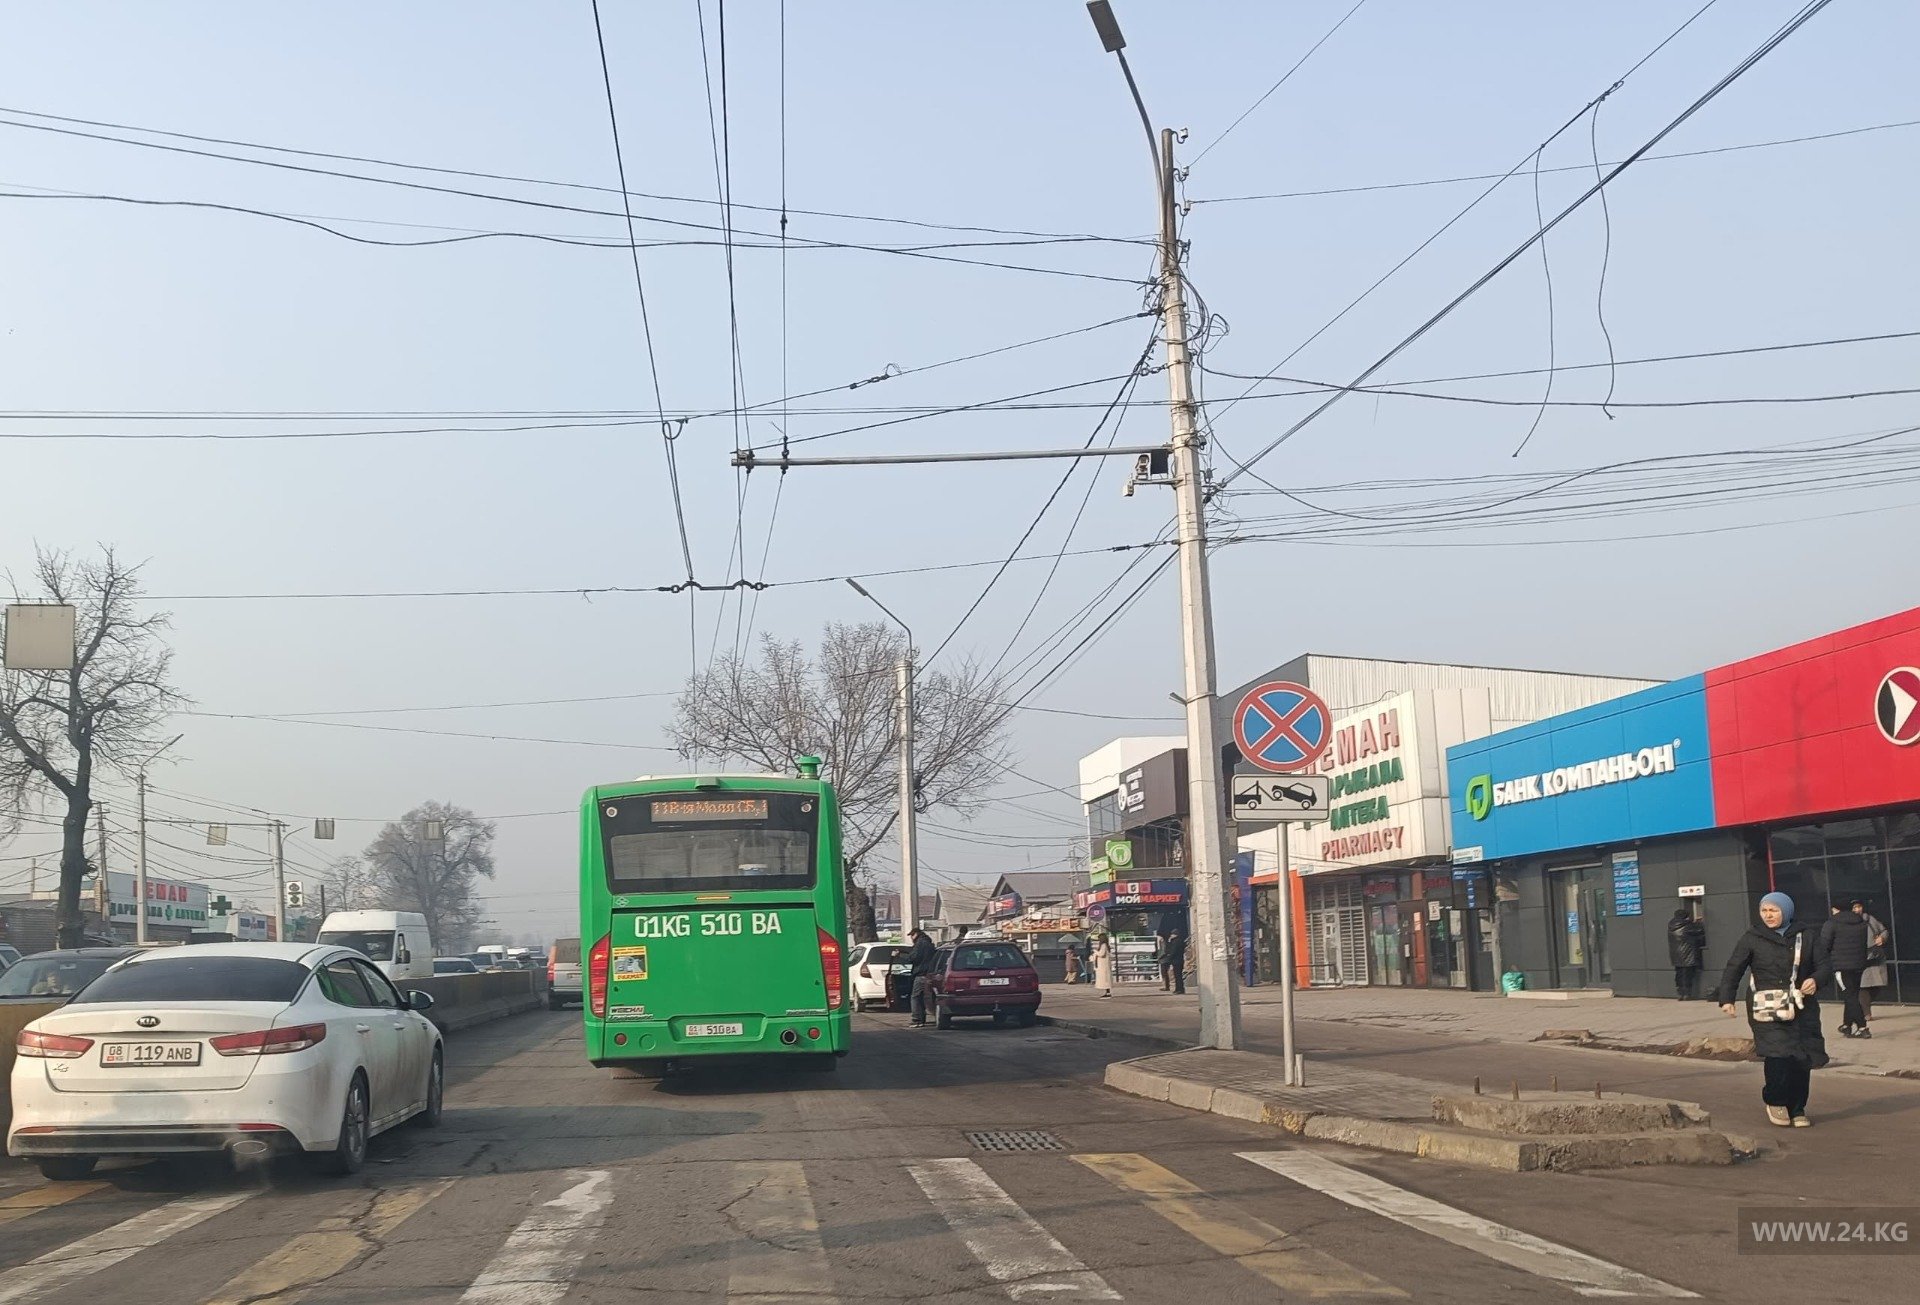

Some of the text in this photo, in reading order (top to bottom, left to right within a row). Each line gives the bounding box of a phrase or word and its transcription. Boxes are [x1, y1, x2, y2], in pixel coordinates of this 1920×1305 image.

[1303, 708, 1400, 775] ЕМАН
[1493, 743, 1676, 807] БАНК КОМПАНЬОН
[1330, 795, 1390, 831] АПТЕКА
[1321, 826, 1404, 861] PHARMACY
[634, 911, 782, 938] 01KG 510 BA
[139, 1017, 158, 1026] KIA
[706, 1024, 725, 1035] 510
[108, 1045, 193, 1061] 08 119 ANB
